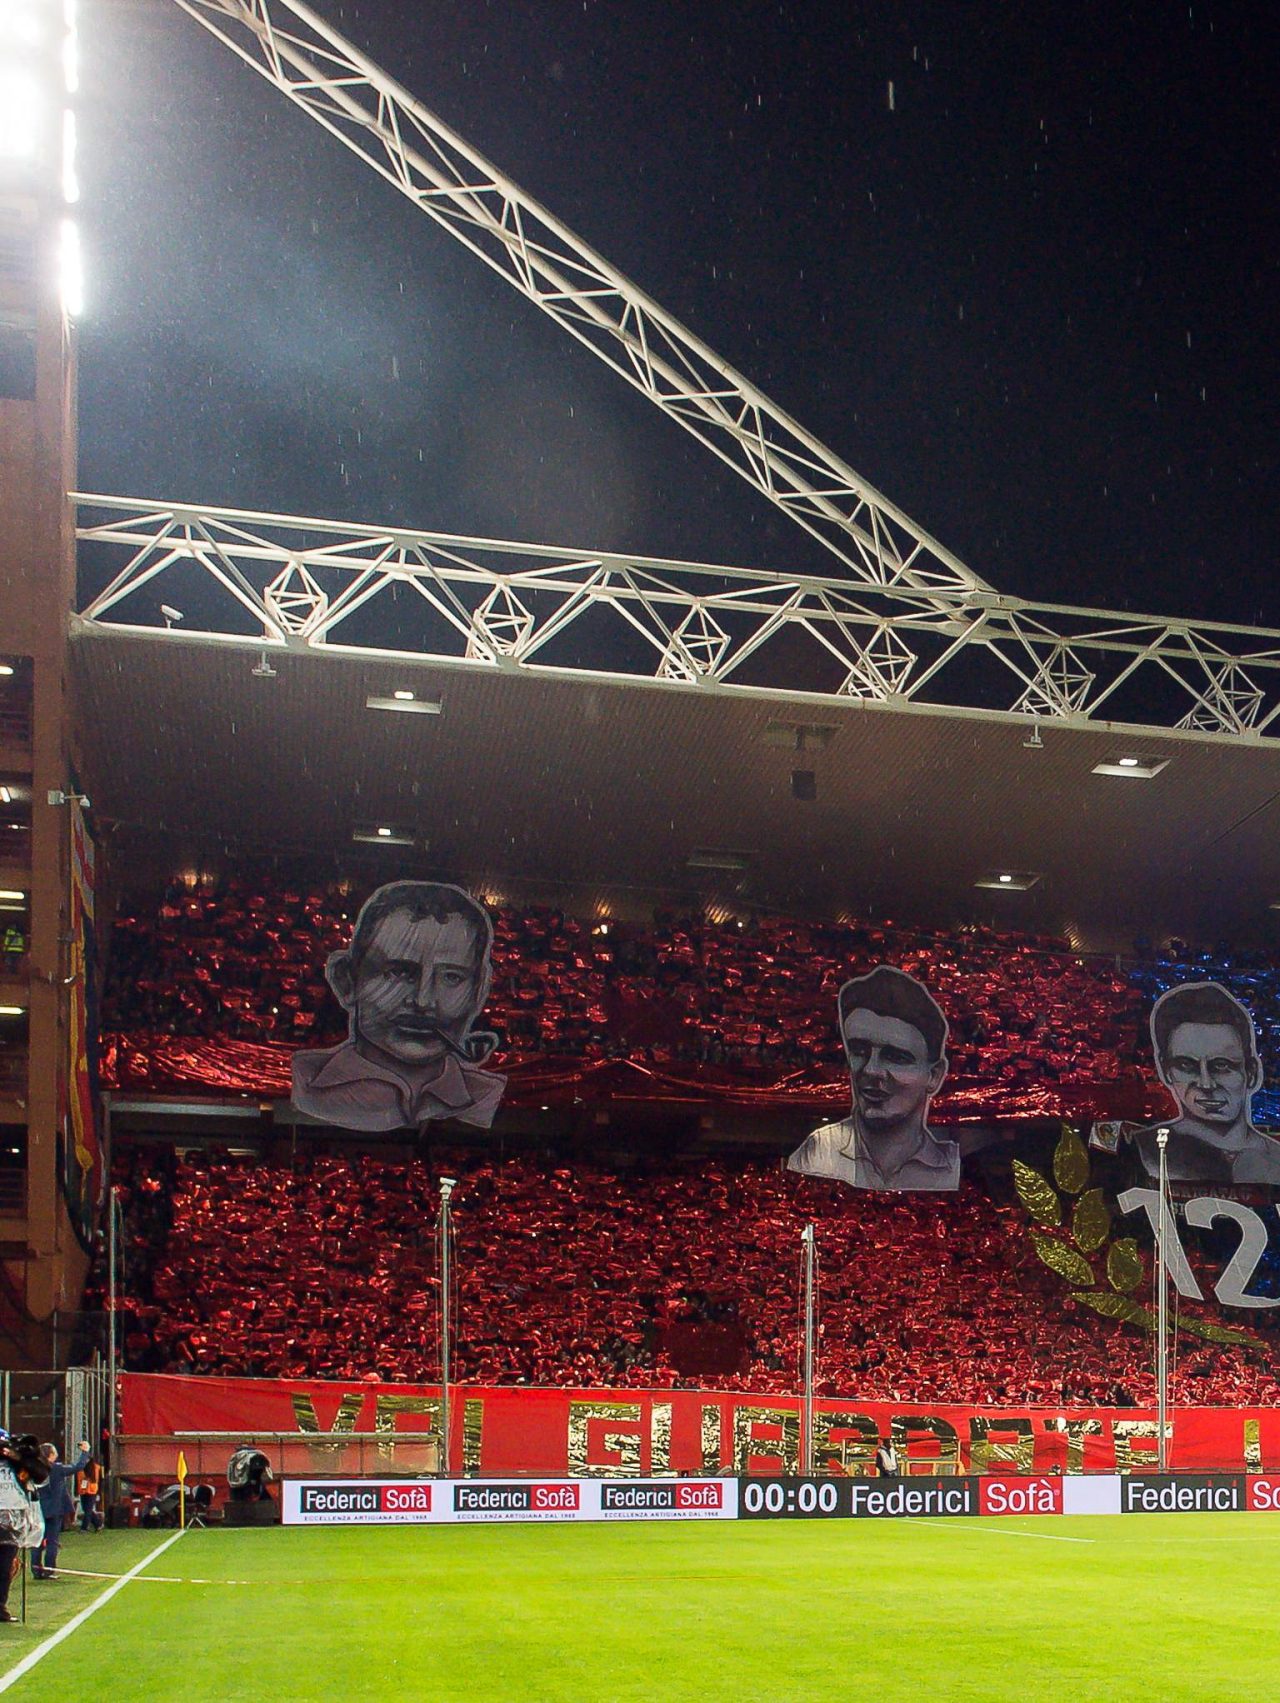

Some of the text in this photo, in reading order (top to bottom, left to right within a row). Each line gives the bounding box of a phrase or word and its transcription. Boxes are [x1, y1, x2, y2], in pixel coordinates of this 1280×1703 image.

[306, 1486, 427, 1510] Federici Sofà
[459, 1485, 576, 1508] Federici Sofà
[606, 1484, 719, 1507] Federici Sofà
[744, 1482, 838, 1512] 00:00
[851, 1479, 1055, 1514] Federici Sofà
[1127, 1480, 1238, 1510] Federici
